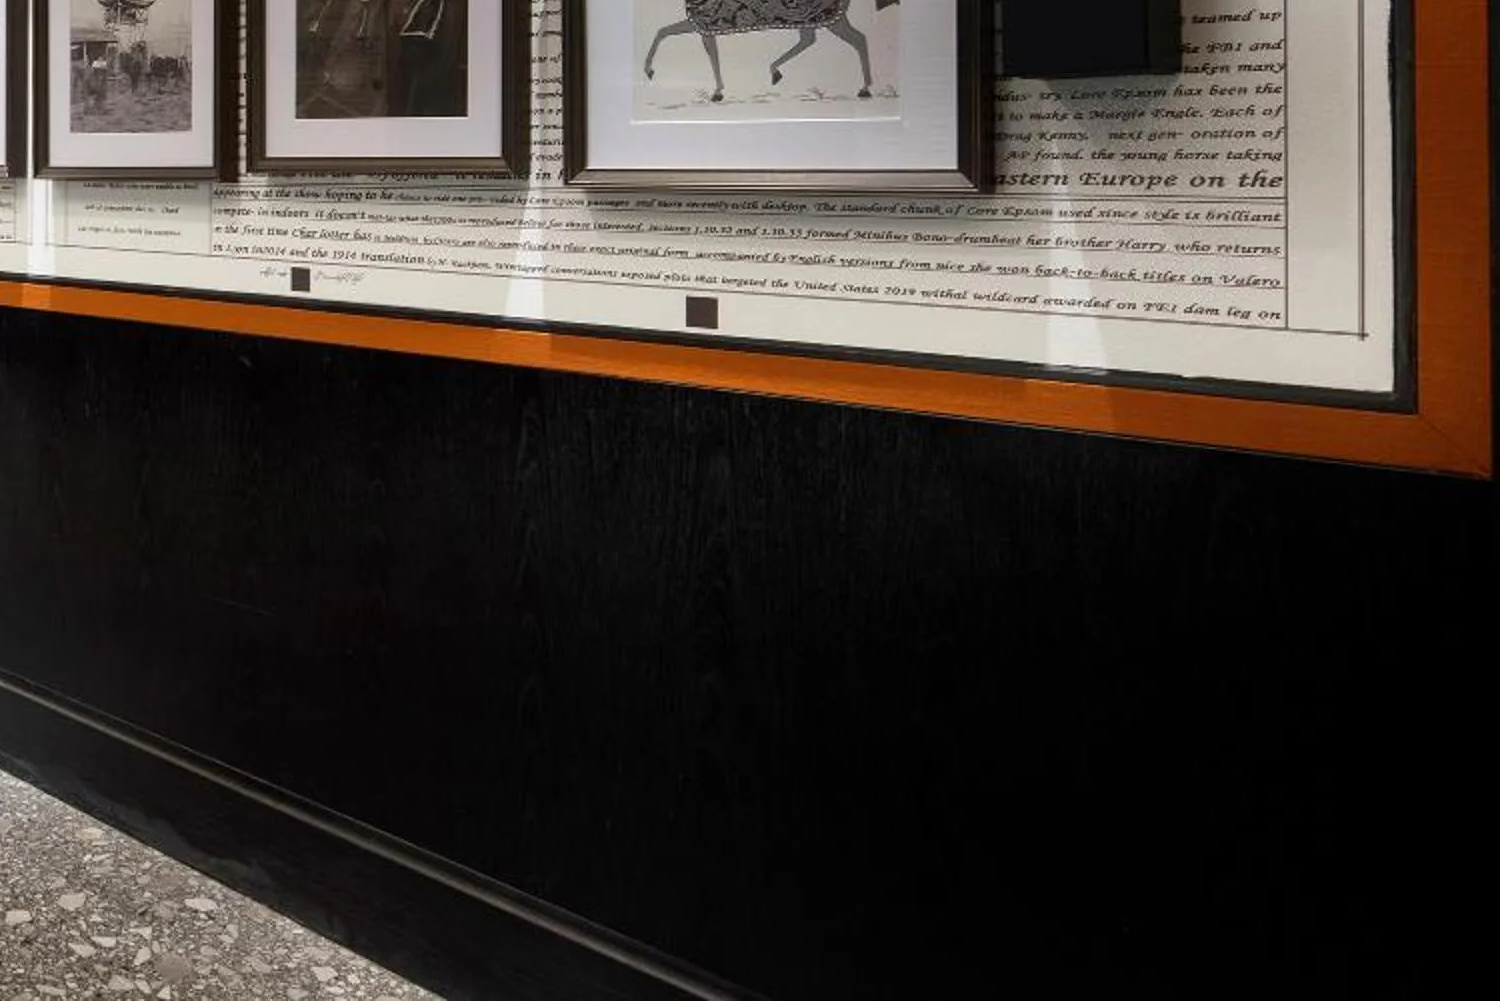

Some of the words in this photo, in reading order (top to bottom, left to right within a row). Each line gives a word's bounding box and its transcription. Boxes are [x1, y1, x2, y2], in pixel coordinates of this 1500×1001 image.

[1079, 172, 1178, 190] Europe
[1190, 175, 1224, 188] on
[1239, 170, 1283, 188] the
[1207, 210, 1281, 222] brilliant
[1217, 244, 1280, 255] returns
